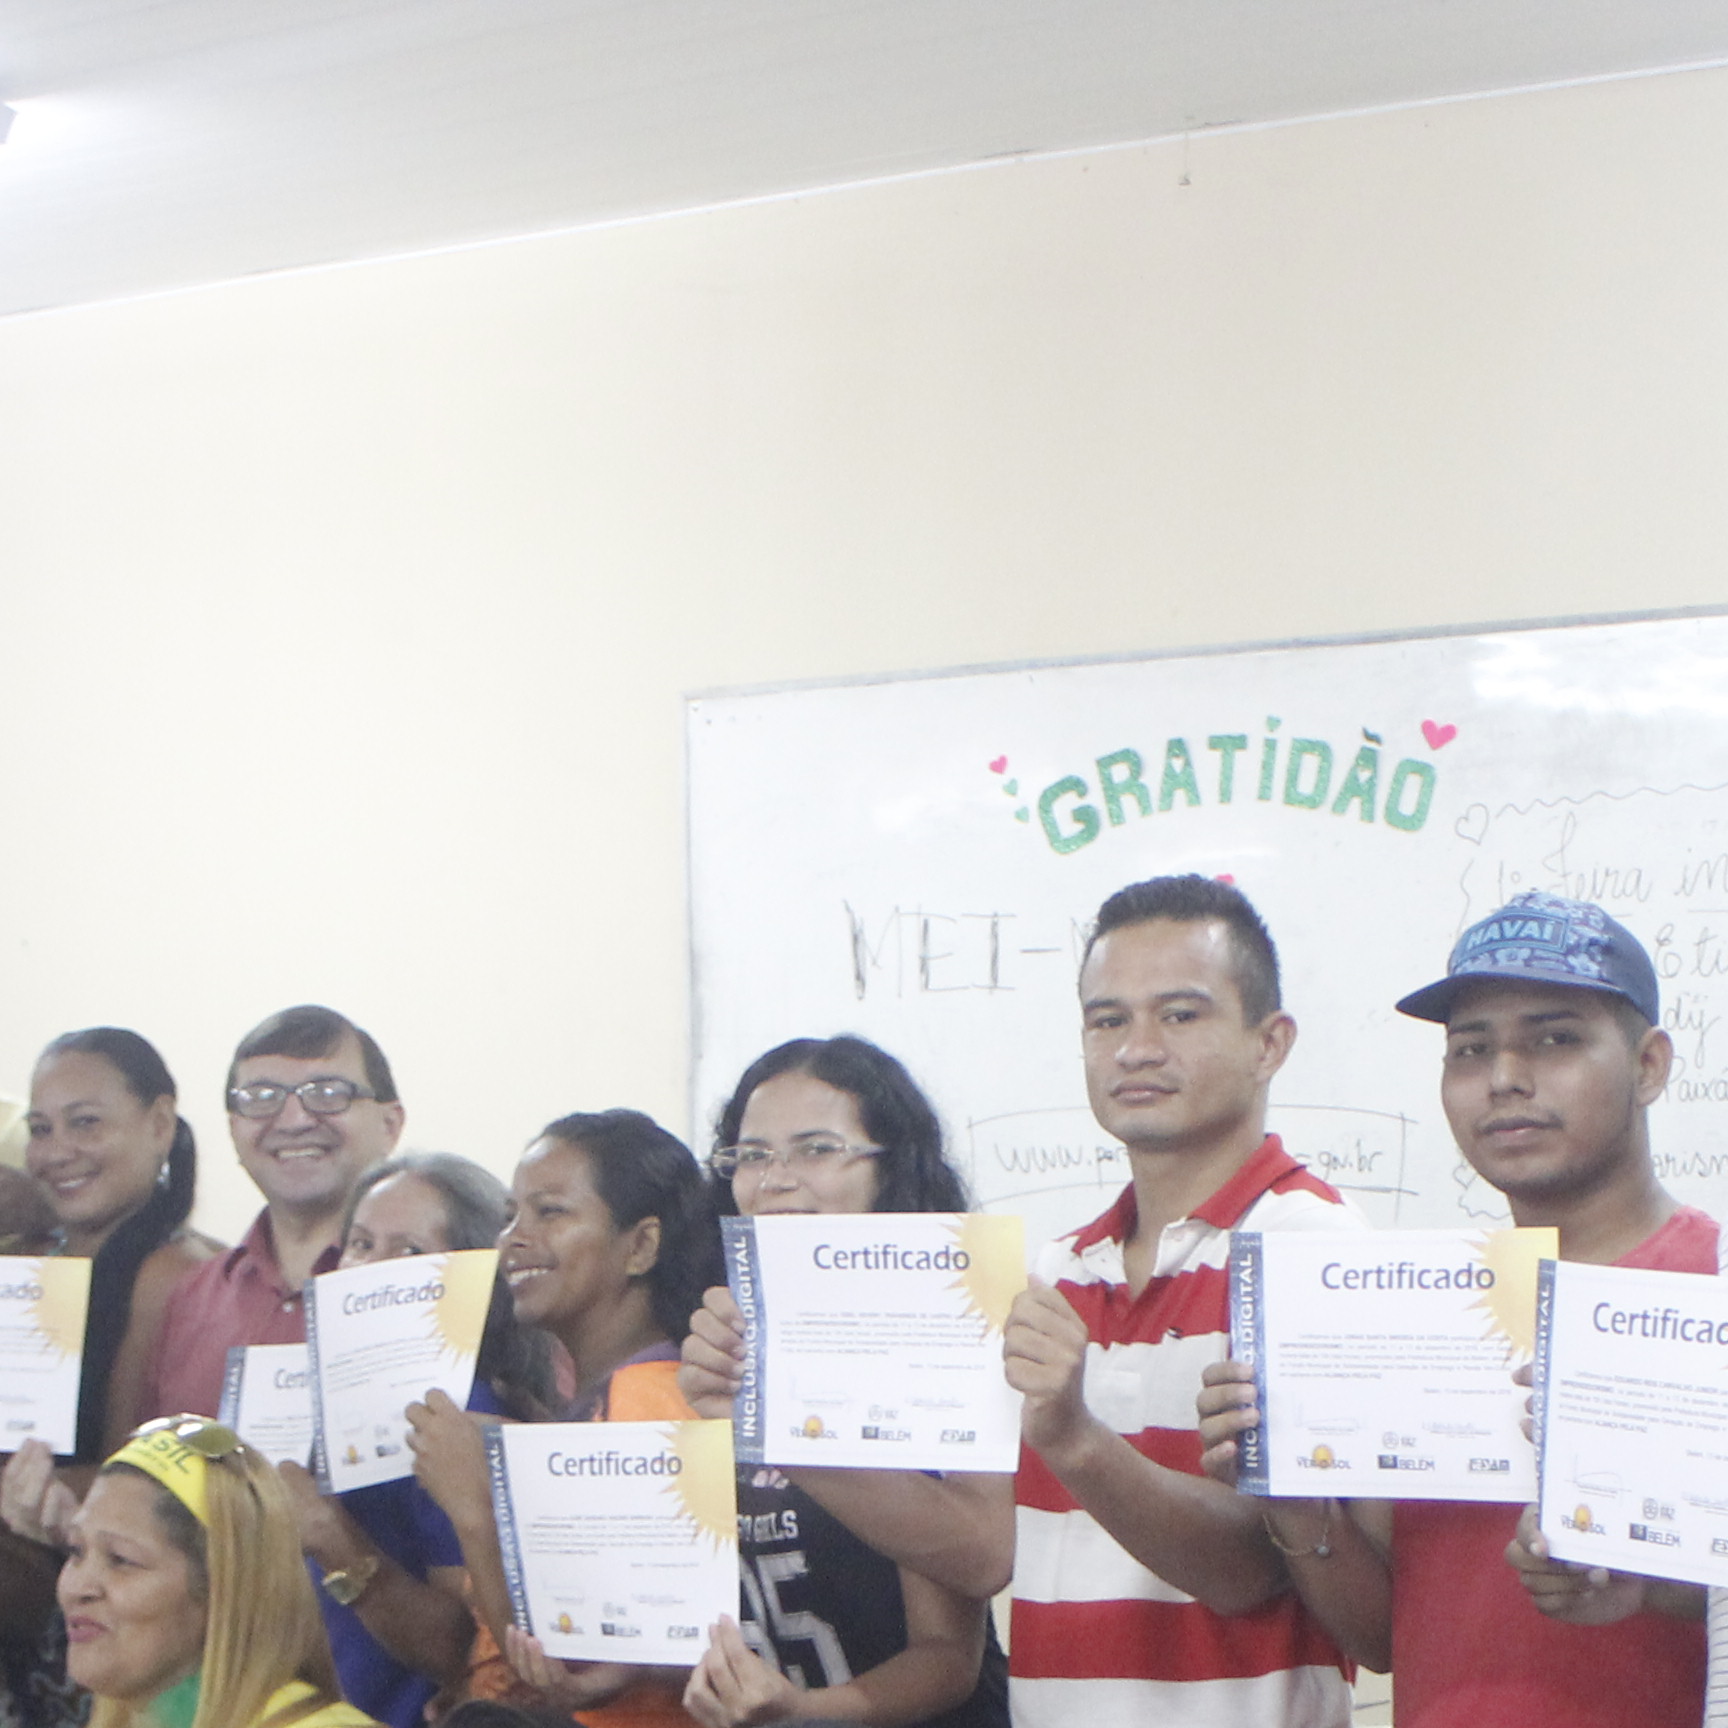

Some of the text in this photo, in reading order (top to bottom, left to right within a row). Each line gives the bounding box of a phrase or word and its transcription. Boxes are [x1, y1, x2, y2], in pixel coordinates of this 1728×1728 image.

[813, 1243, 971, 1271] Certificado
[1321, 1261, 1496, 1291] Certificado
[343, 1281, 446, 1316] Certificado
[1240, 1253, 1256, 1343] DIGITAL
[548, 1450, 683, 1478] Certificado
